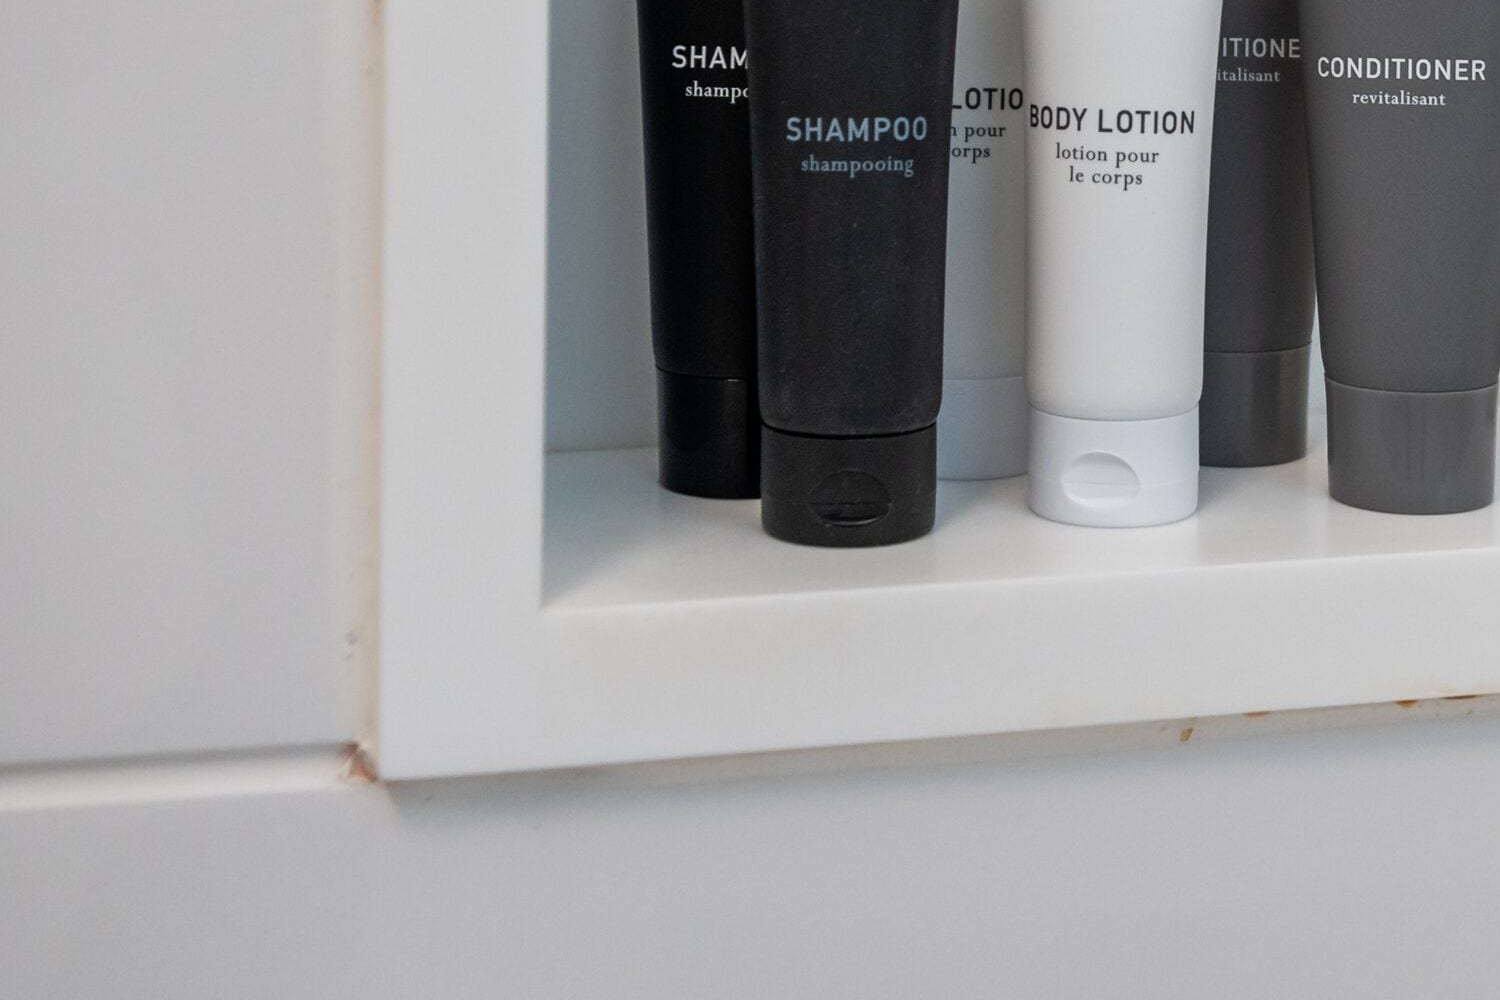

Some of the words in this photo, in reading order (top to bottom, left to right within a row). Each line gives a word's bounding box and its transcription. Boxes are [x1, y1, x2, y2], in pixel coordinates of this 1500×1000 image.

[671, 44, 748, 70] SHAM
[1222, 37, 1300, 58] ITIONE
[1217, 67, 1280, 82] italisant
[1317, 56, 1487, 81] CONDITIONER
[952, 87, 1024, 111] OTIO
[1352, 89, 1446, 106] revitalisant
[786, 115, 928, 142] SHAMPOO
[1029, 103, 1087, 132] BODY
[1098, 108, 1195, 135] LOTION
[964, 126, 1007, 143] pour
[801, 153, 914, 179] shampooing
[951, 147, 991, 164] orps
[1055, 141, 1108, 162] lotion
[1115, 150, 1160, 169] pour
[1069, 165, 1085, 183] le
[1091, 172, 1143, 192] corps
